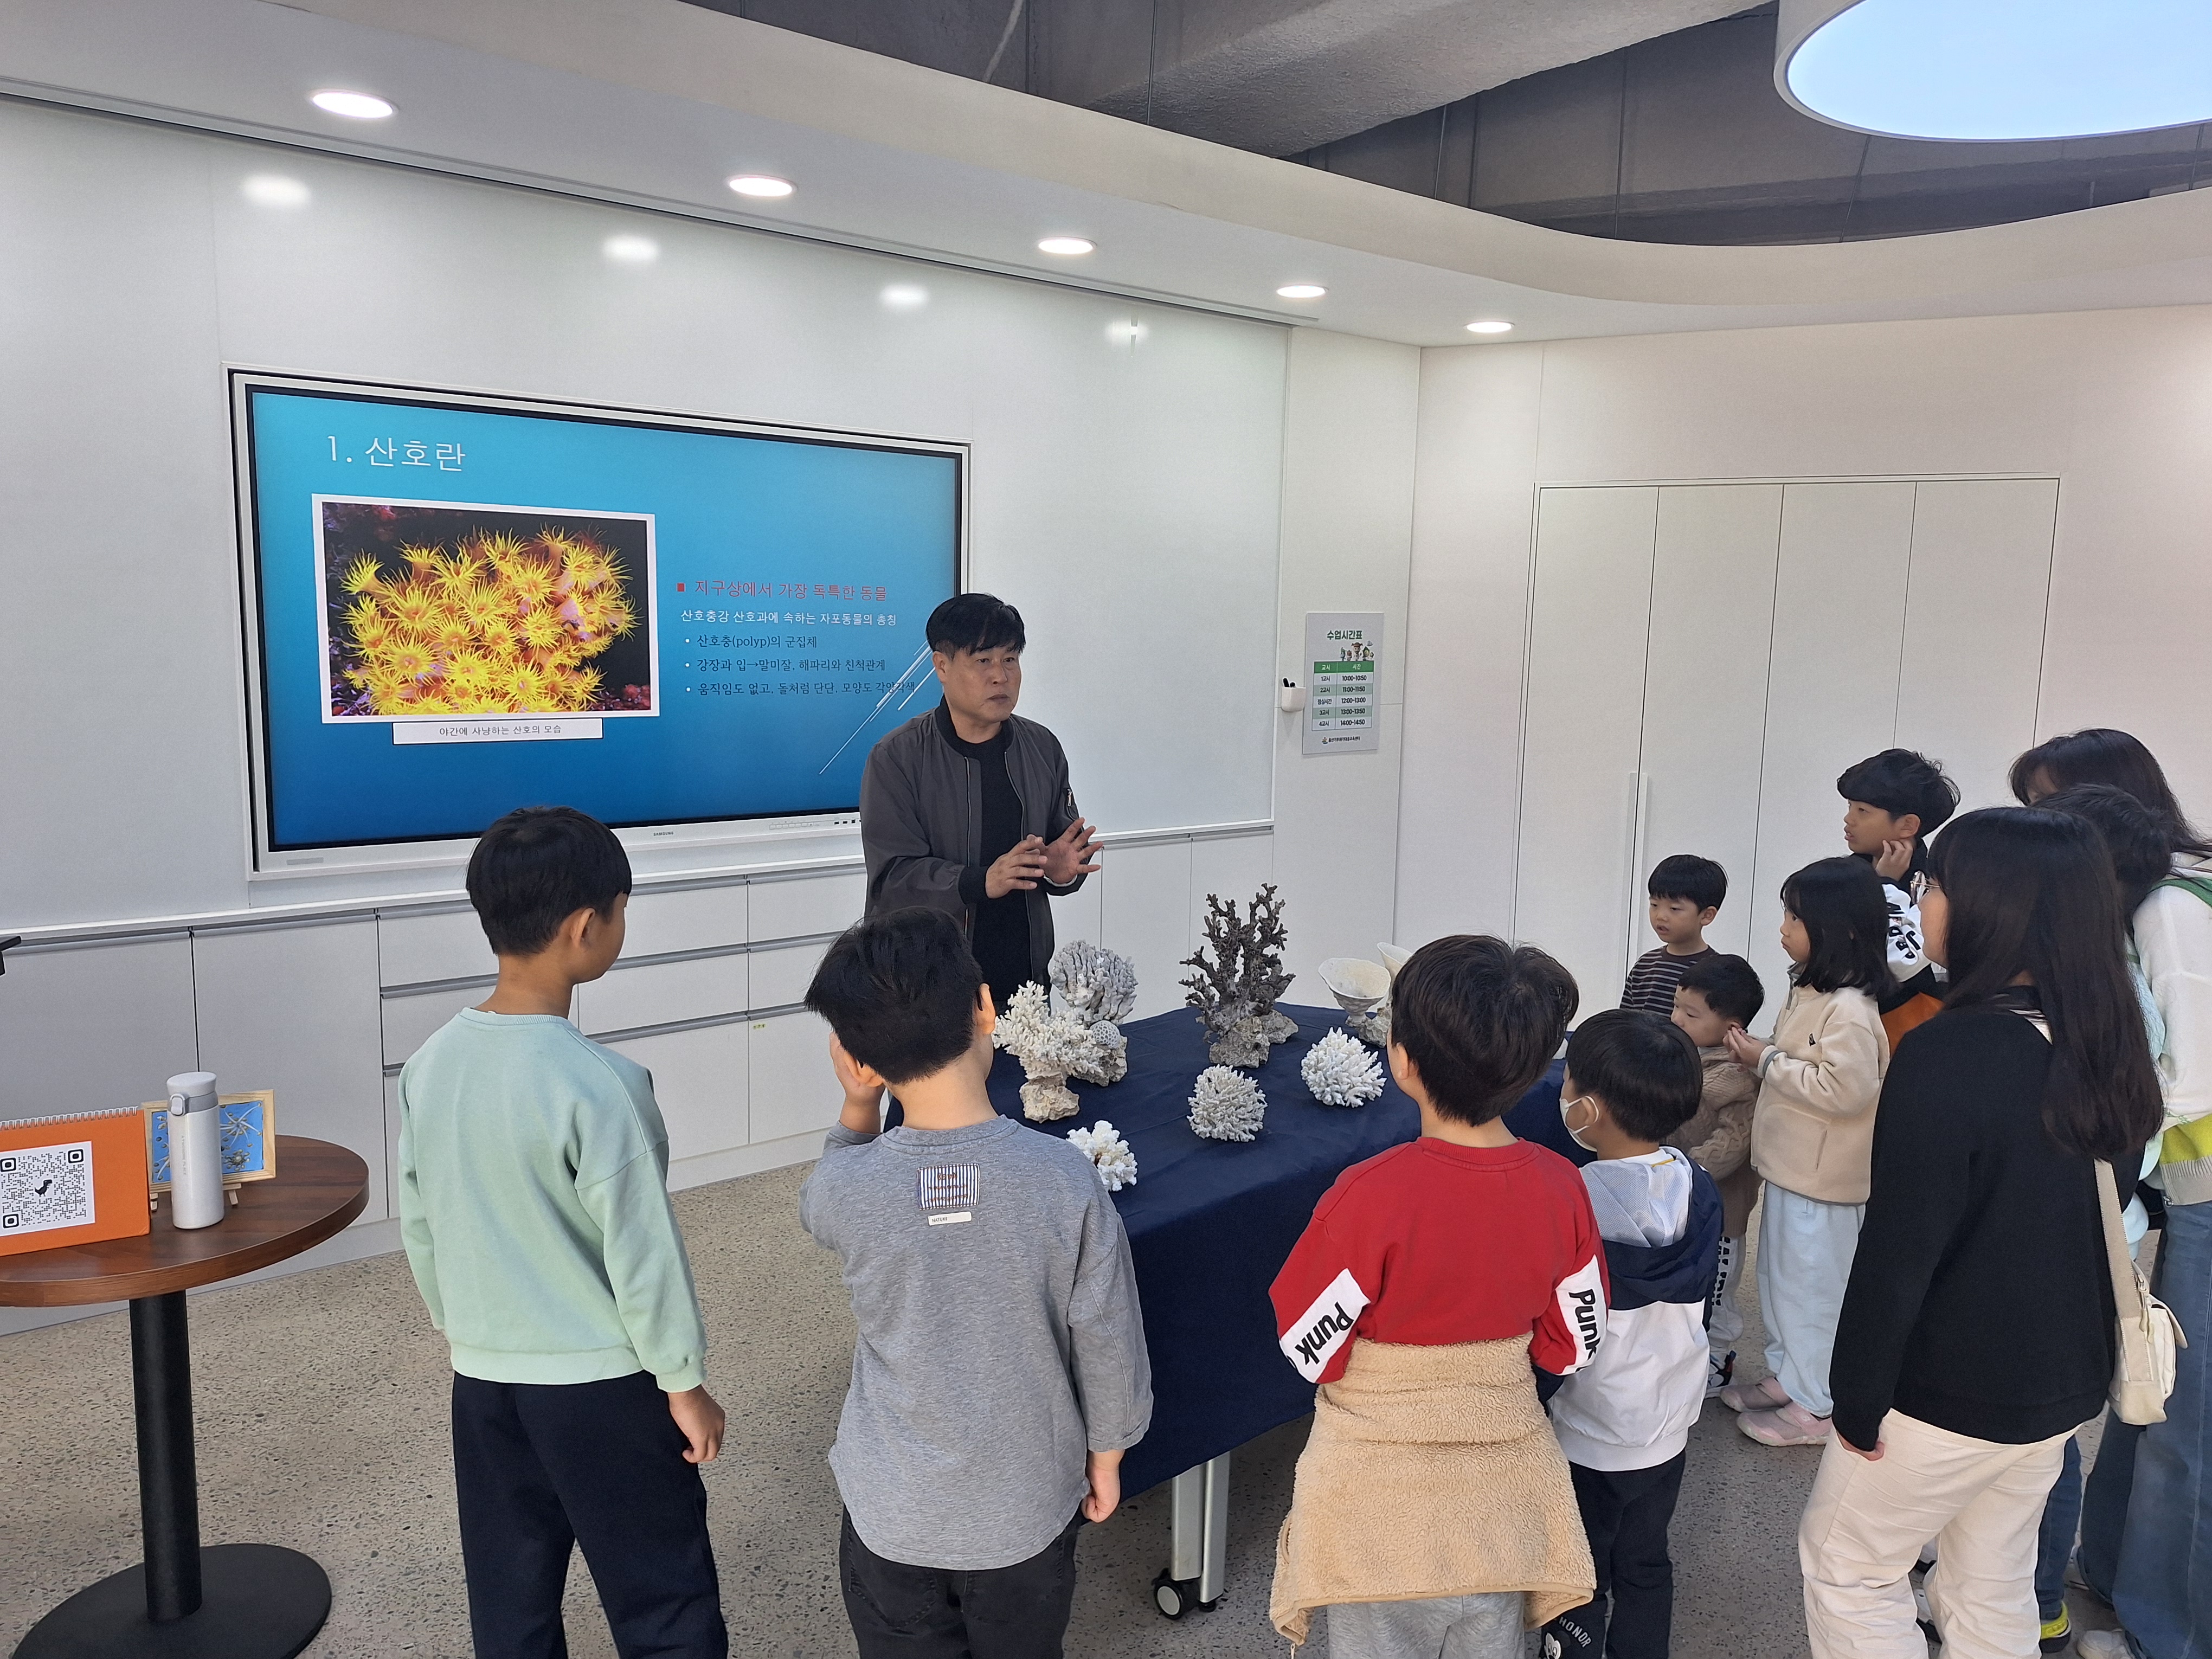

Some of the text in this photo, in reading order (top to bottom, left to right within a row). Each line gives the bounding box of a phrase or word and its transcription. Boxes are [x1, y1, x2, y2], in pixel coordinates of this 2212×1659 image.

[327, 435, 466, 471] 1. 산호란
[695, 580, 887, 601] 지구상에서 가장 독특한 동물
[681, 610, 896, 626] 산호충강 산호과에 속하는 자포동물의 총칭
[697, 634, 817, 648] 산호충(polyp)의 군집체
[1327, 630, 1362, 640] 수업시간표
[697, 659, 732, 672] 강장과
[799, 659, 841, 671] 해파리와
[845, 659, 885, 671] 친척관계
[698, 683, 744, 695] 움직임도
[777, 683, 809, 695] 돌처럼
[841, 681, 872, 693] 모양도
[876, 681, 915, 693] 각양각색
[439, 724, 562, 736] 야간에 사냥하는 산호의 모습
[1568, 1289, 1601, 1360] Punk
[1295, 1301, 1354, 1365] Punk
[1559, 1616, 1592, 1648] HONOR
